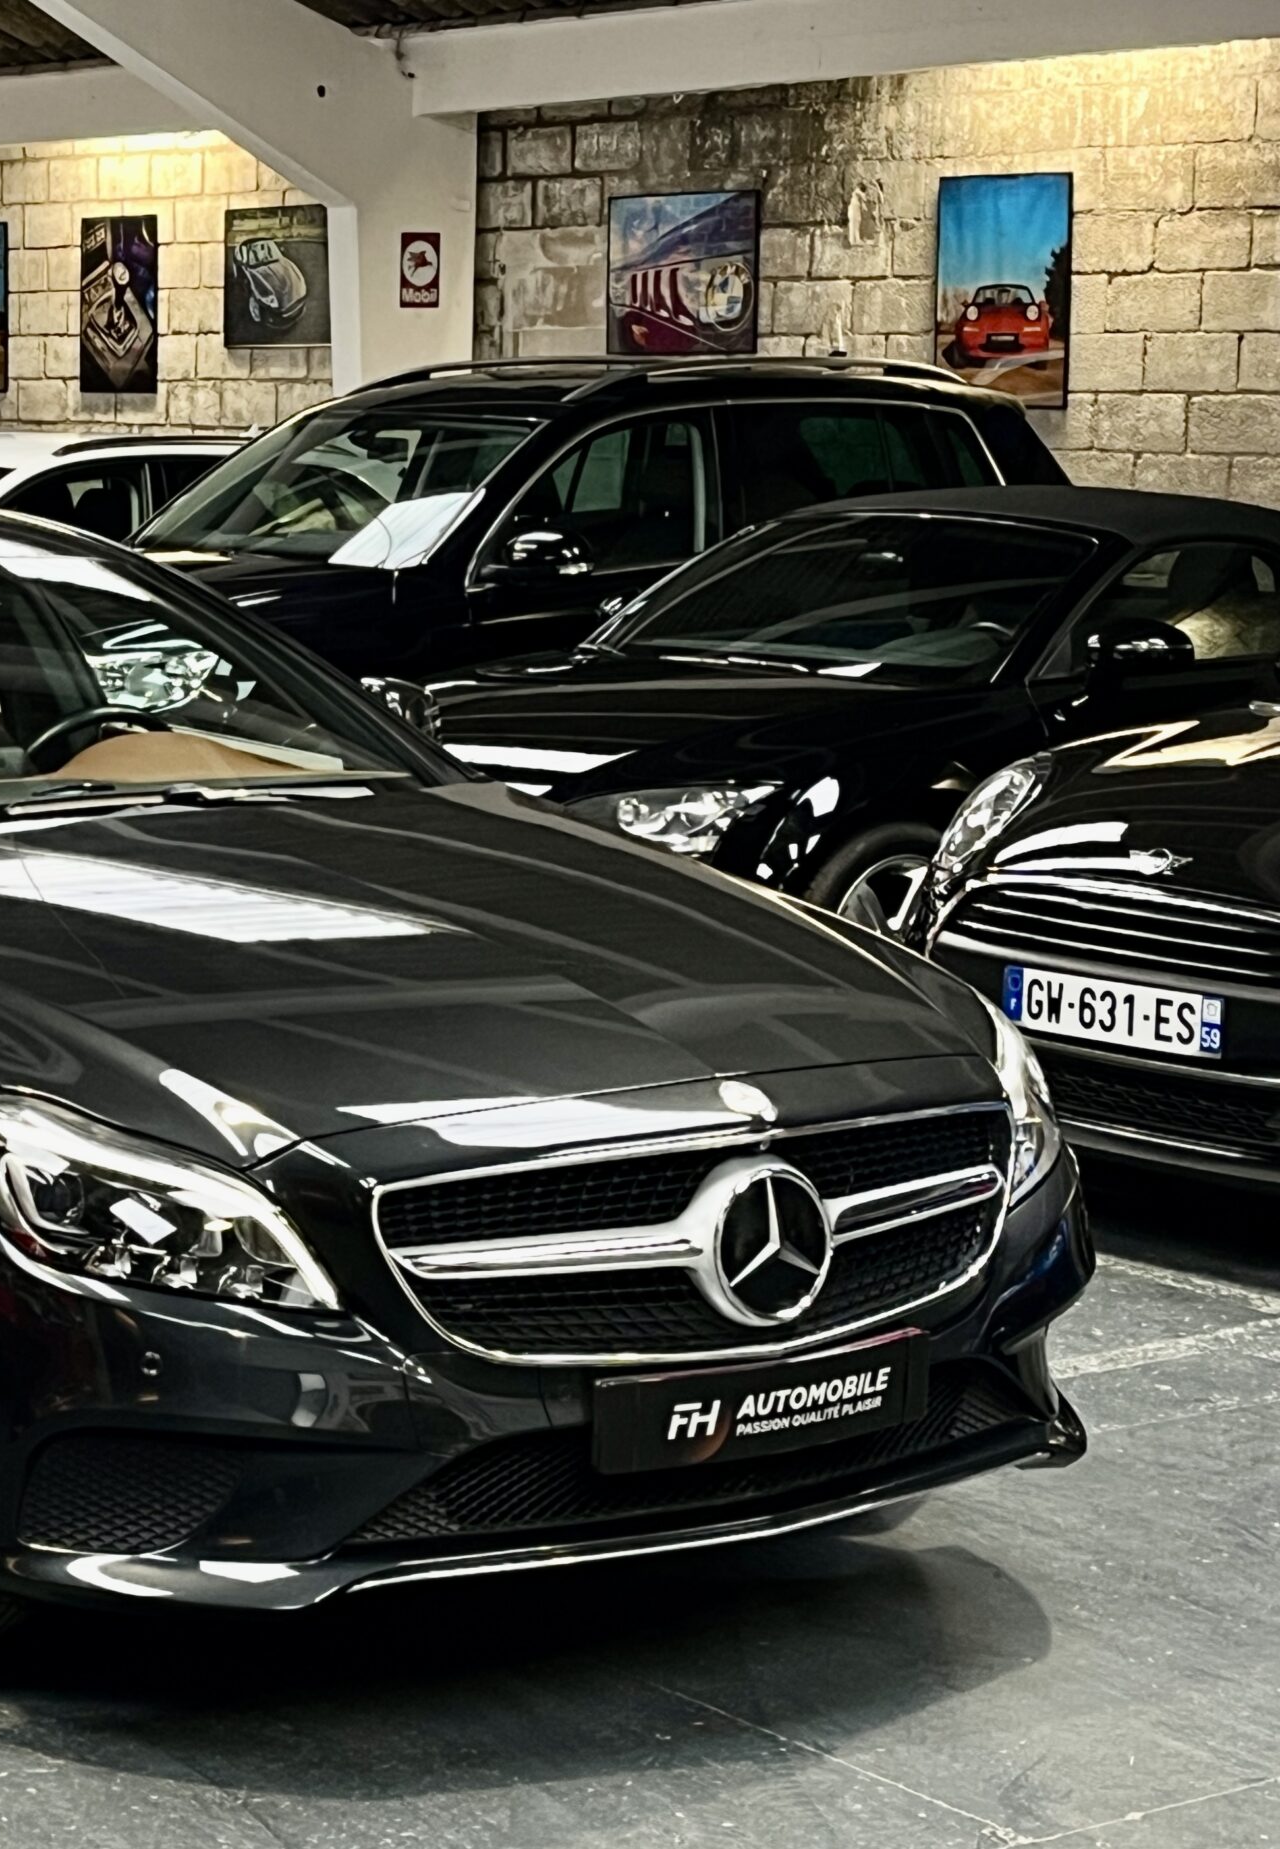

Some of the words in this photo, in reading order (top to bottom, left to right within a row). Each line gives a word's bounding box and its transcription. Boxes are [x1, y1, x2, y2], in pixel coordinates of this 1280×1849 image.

[401, 287, 438, 303] Mobil
[1009, 998, 1018, 1012] F
[1027, 979, 1196, 1045] GW-631-ES
[1201, 1027, 1220, 1049] 59
[736, 1367, 891, 1419] AUTOMOBILE
[735, 1414, 790, 1437] PASSION
[792, 1404, 840, 1427] QUALITÉ
